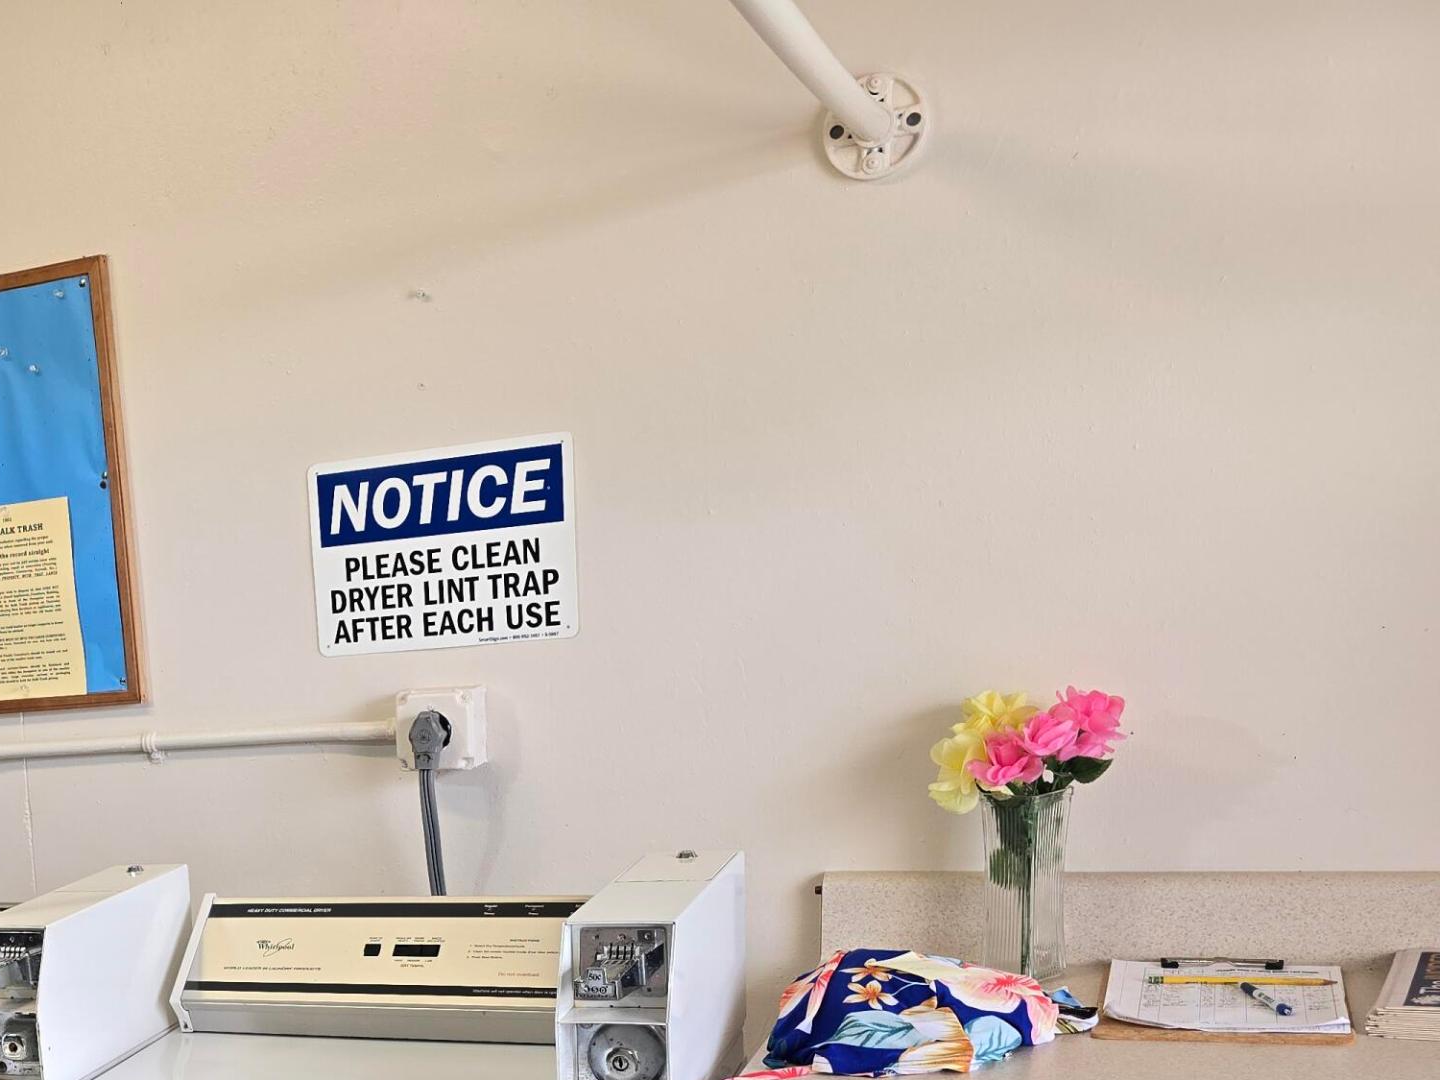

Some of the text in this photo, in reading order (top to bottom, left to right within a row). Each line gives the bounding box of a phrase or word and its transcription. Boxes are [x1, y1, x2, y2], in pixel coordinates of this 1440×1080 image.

[330, 458, 551, 535] NOTICE
[17, 523, 43, 533] TRASH
[10, 550, 27, 558] record
[29, 548, 50, 556] straight
[345, 537, 541, 582] PLEASE CLEAN
[331, 569, 559, 614] DRYER LINT TRAP
[334, 601, 561, 645] AFTER EACH USE
